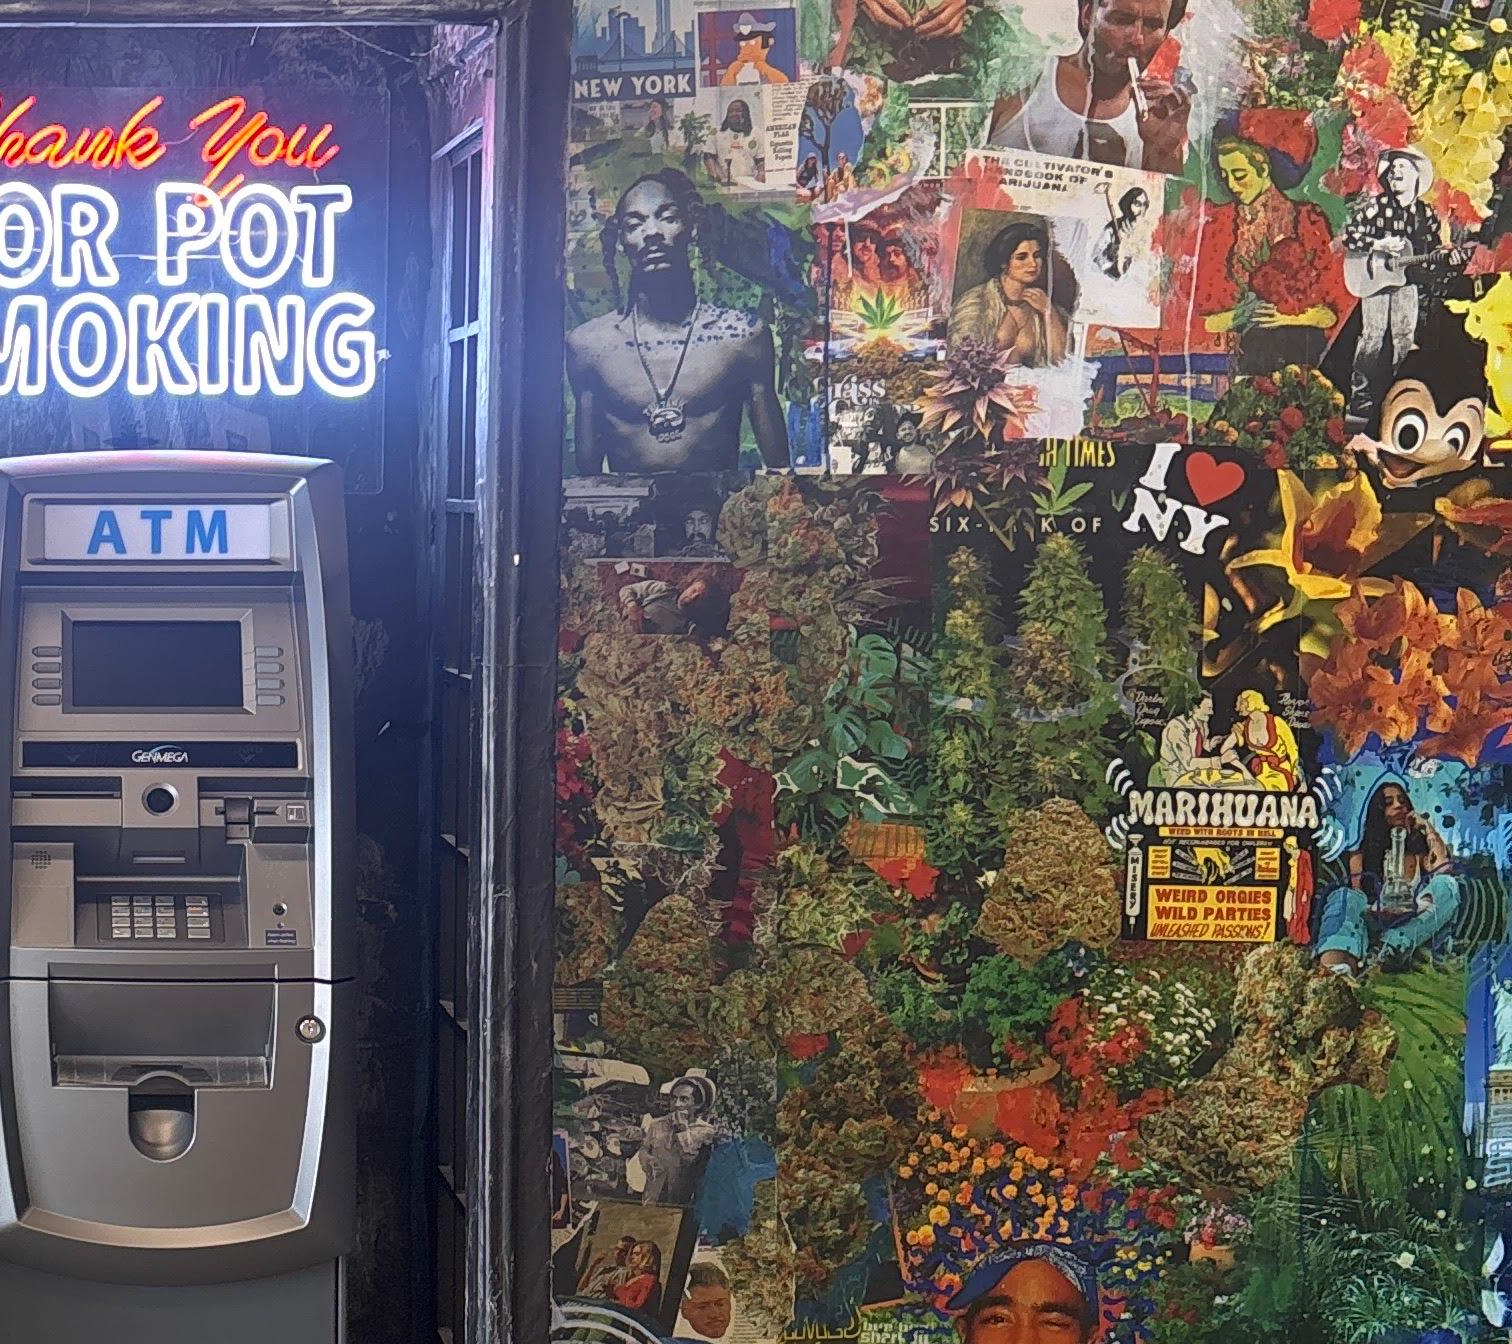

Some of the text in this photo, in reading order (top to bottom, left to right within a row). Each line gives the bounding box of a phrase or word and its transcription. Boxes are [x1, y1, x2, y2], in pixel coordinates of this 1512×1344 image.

[573, 73, 693, 100] NEW YORK
[189, 94, 341, 209] You
[1069, 175, 1088, 185] OF
[155, 181, 354, 288] POT
[1065, 440, 1116, 468] TIMES
[1139, 443, 1182, 491] I
[87, 509, 229, 555] ATM
[1071, 517, 1103, 533] OF
[1121, 488, 1231, 555] NY
[131, 748, 189, 764] GENMEGA
[1127, 789, 1319, 829] MARIHUANA
[1168, 828, 1192, 836] WEED
[1257, 829, 1276, 837] HELL
[1130, 857, 1140, 910] MISERY
[1155, 888, 1272, 905] WEIRD ORGIES
[1155, 906, 1272, 922] WILD PARTIES
[1149, 922, 1210, 938] UNLEASHED
